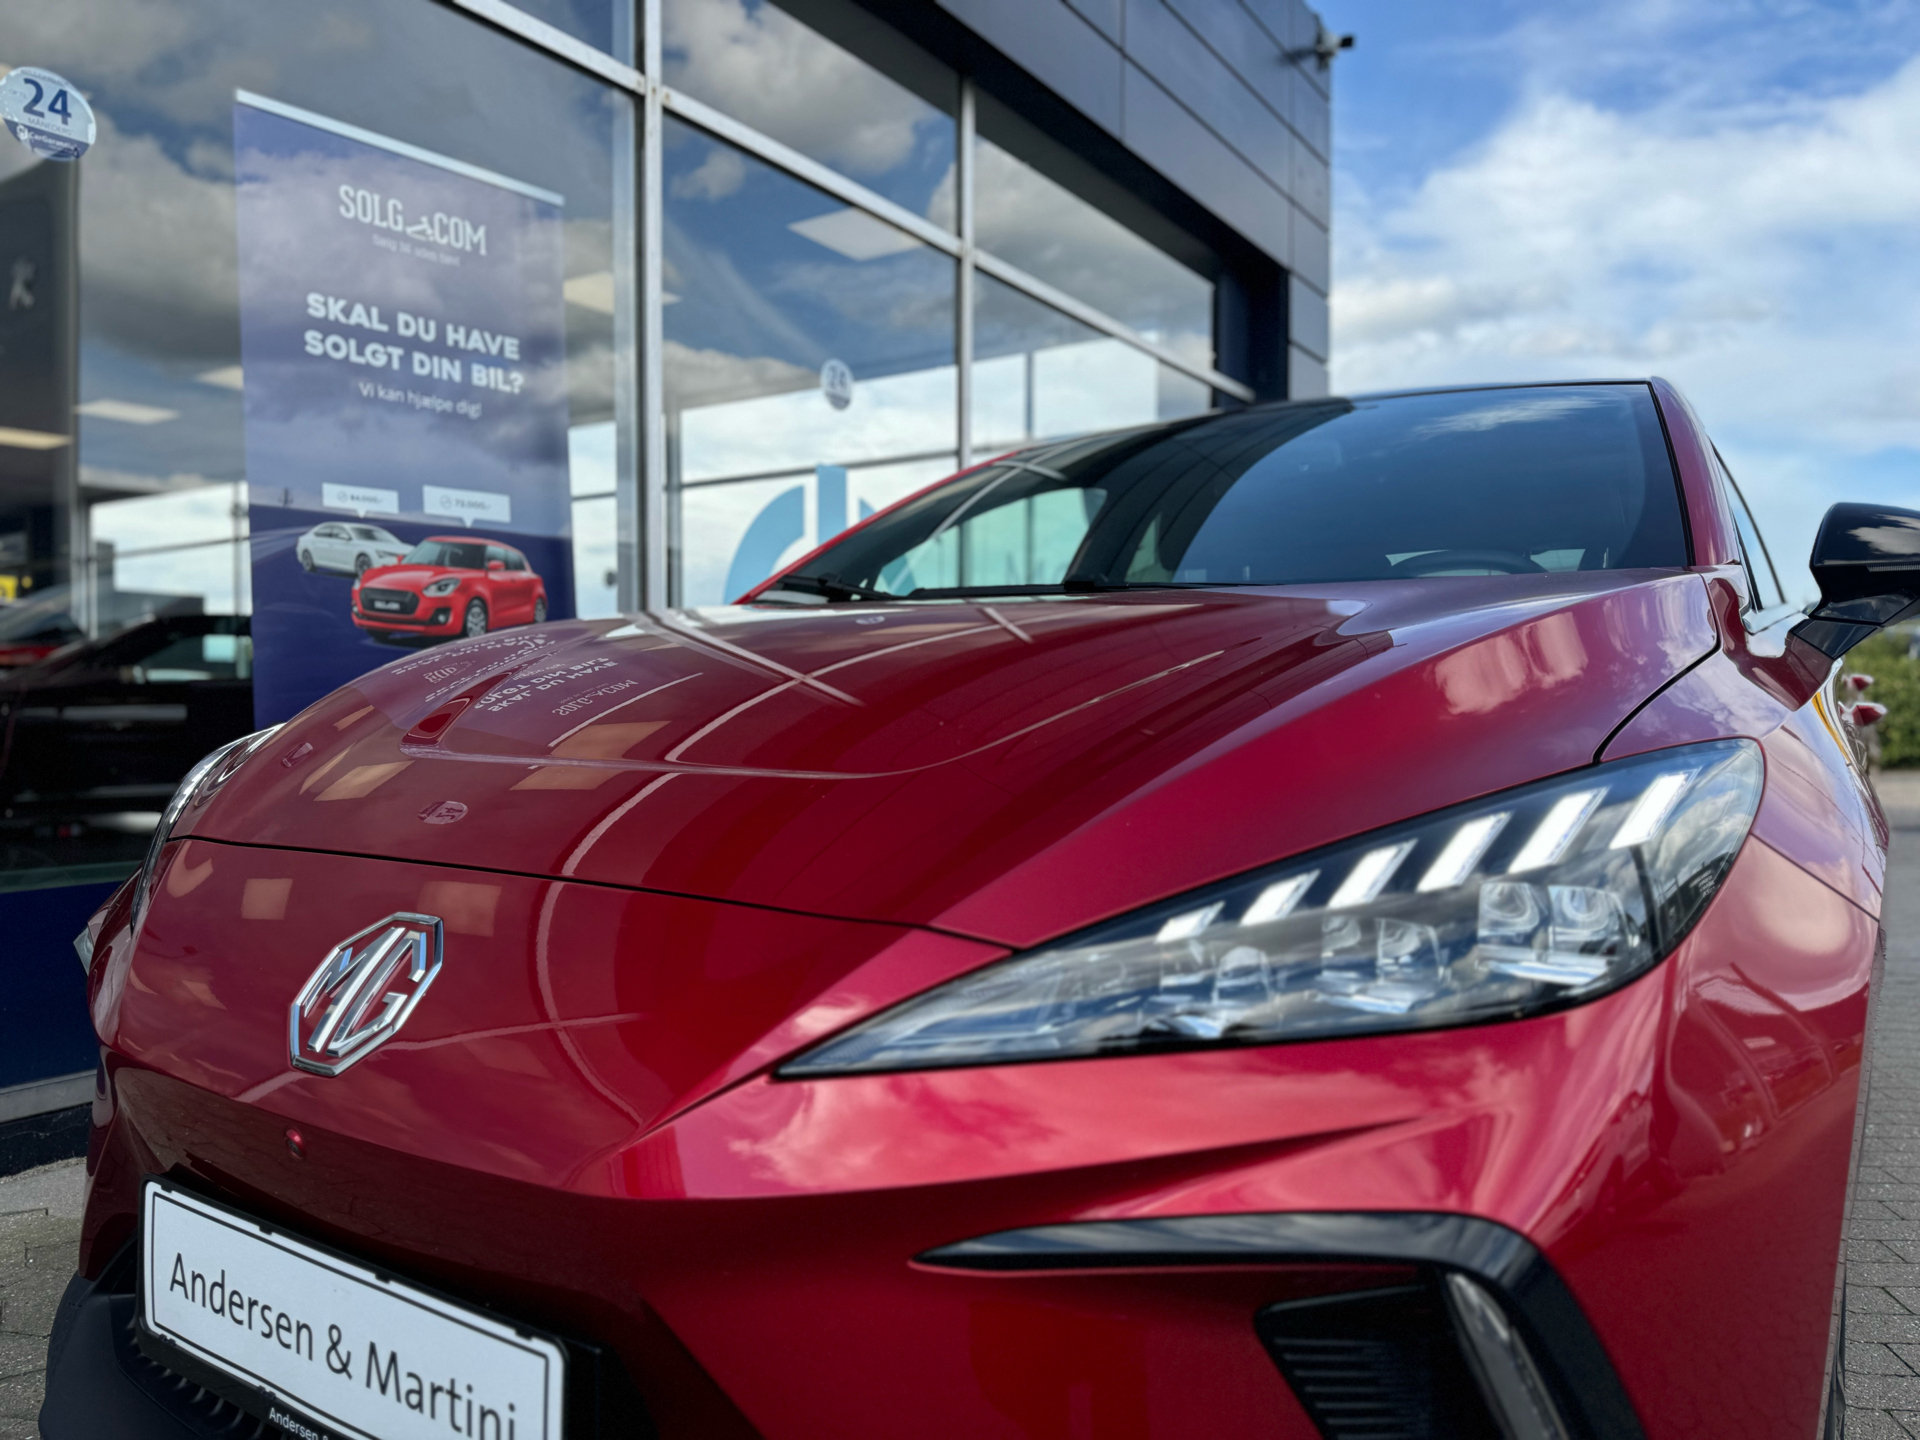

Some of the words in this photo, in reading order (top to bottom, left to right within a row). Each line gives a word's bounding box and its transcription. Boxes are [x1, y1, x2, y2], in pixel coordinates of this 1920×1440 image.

[23, 77, 72, 126] 24
[306, 292, 389, 332] SKAL
[397, 311, 437, 342] DU
[446, 323, 520, 361] HAVE
[304, 329, 404, 370] SOLGT
[412, 351, 462, 383] DIN
[470, 362, 524, 394] BIL?
[358, 382, 374, 398] Vi
[377, 384, 405, 403] kan
[407, 389, 454, 414] hjælpe
[456, 400, 482, 420] dig!
[302, 926, 427, 1059] MG
[169, 1252, 313, 1361] Andersen
[326, 1323, 353, 1381] &
[365, 1340, 516, 1440] Martini
